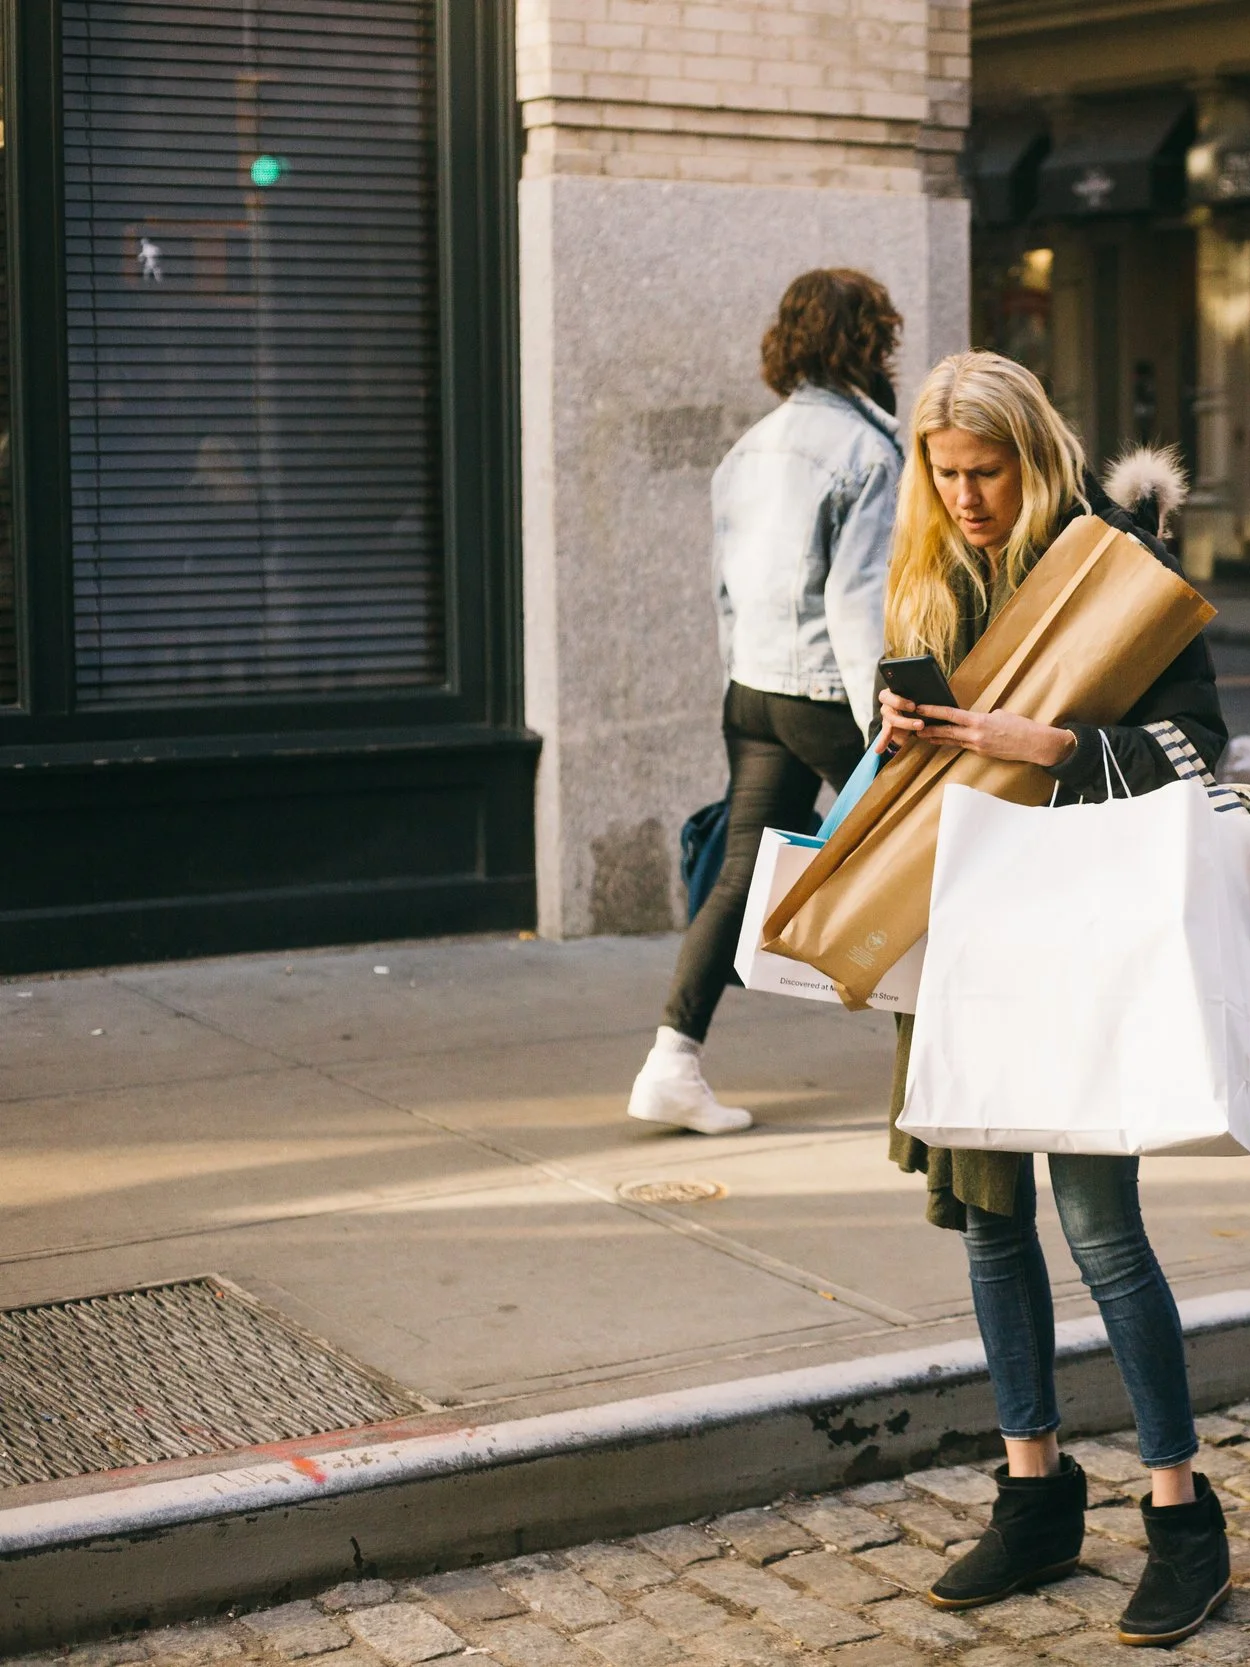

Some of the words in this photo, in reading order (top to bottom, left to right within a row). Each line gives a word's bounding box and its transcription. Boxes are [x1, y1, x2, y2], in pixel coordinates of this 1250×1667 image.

[780, 977, 820, 990] Discovered
[821, 983, 829, 991] at
[879, 991, 899, 1002] Store
